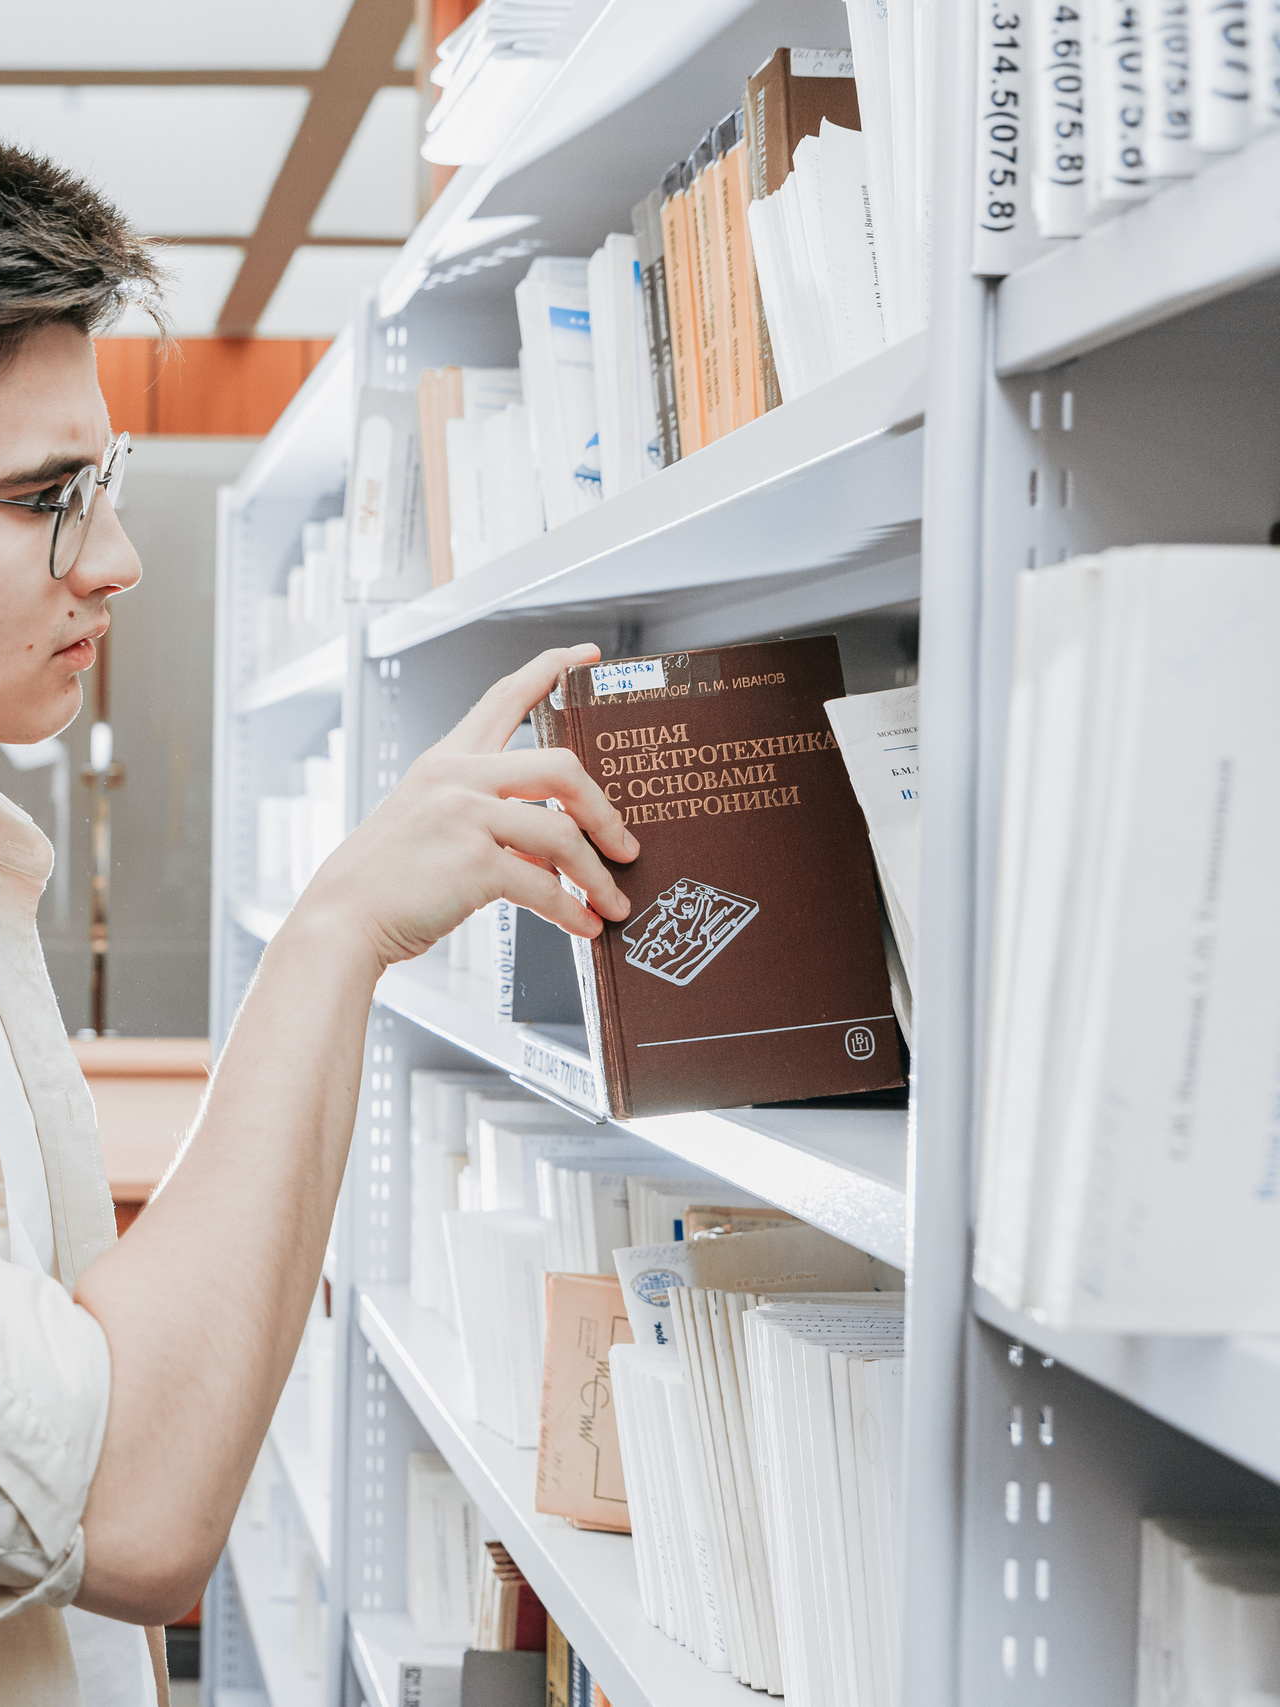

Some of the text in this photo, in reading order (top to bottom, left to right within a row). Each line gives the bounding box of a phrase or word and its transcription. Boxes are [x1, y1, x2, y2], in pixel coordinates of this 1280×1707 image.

[627, 684, 689, 704] ДАНИЛОВ
[732, 672, 786, 689] ИВАНОВ
[596, 723, 689, 755] ОБЩАЯ
[600, 729, 839, 778] ЭЛЕКТРОТЕХНИКА
[622, 763, 777, 800] ОСНОВАМИ
